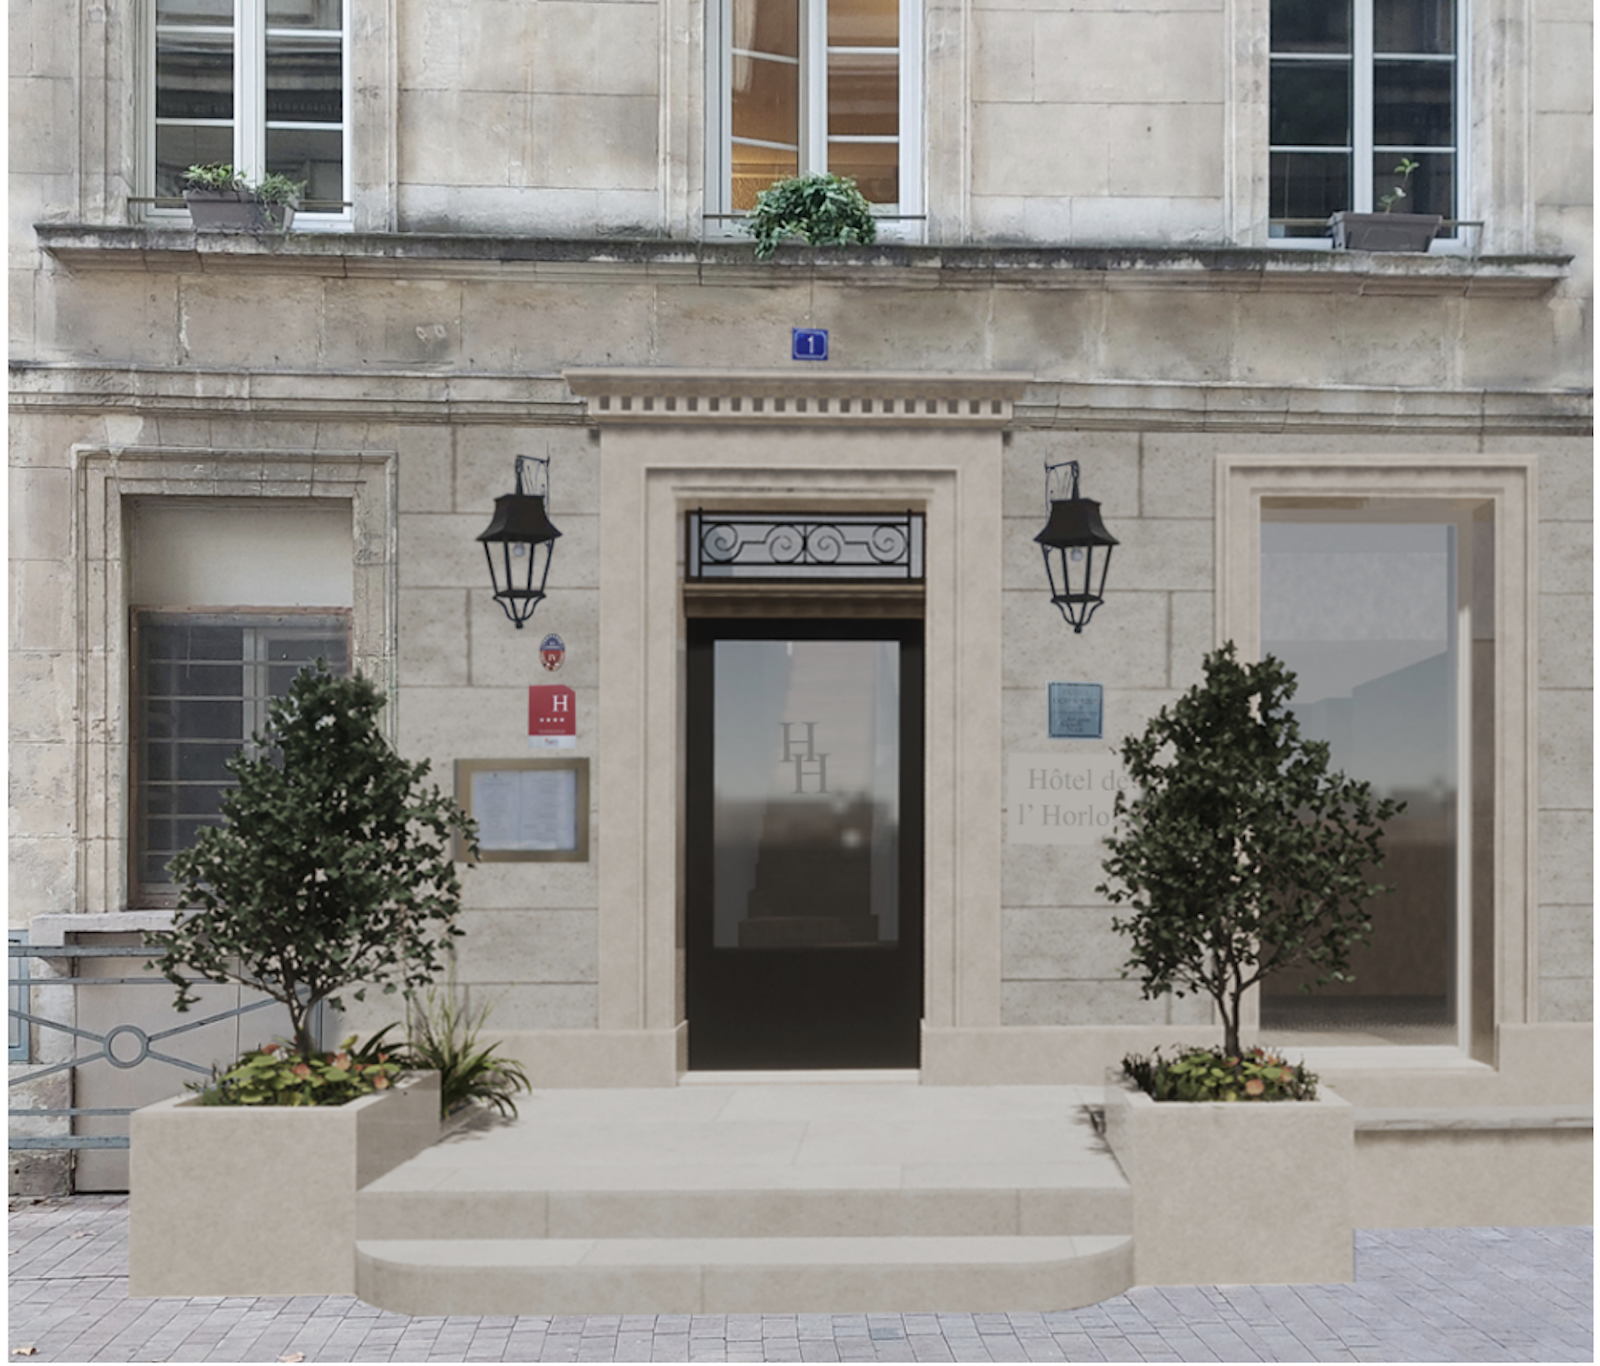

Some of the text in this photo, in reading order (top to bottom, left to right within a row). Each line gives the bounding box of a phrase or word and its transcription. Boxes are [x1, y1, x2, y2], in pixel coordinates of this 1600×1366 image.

[807, 335, 814, 354] 1
[552, 694, 569, 712] H
[1028, 768, 1130, 791] Hôtel de
[1041, 804, 1111, 827] Horlo
